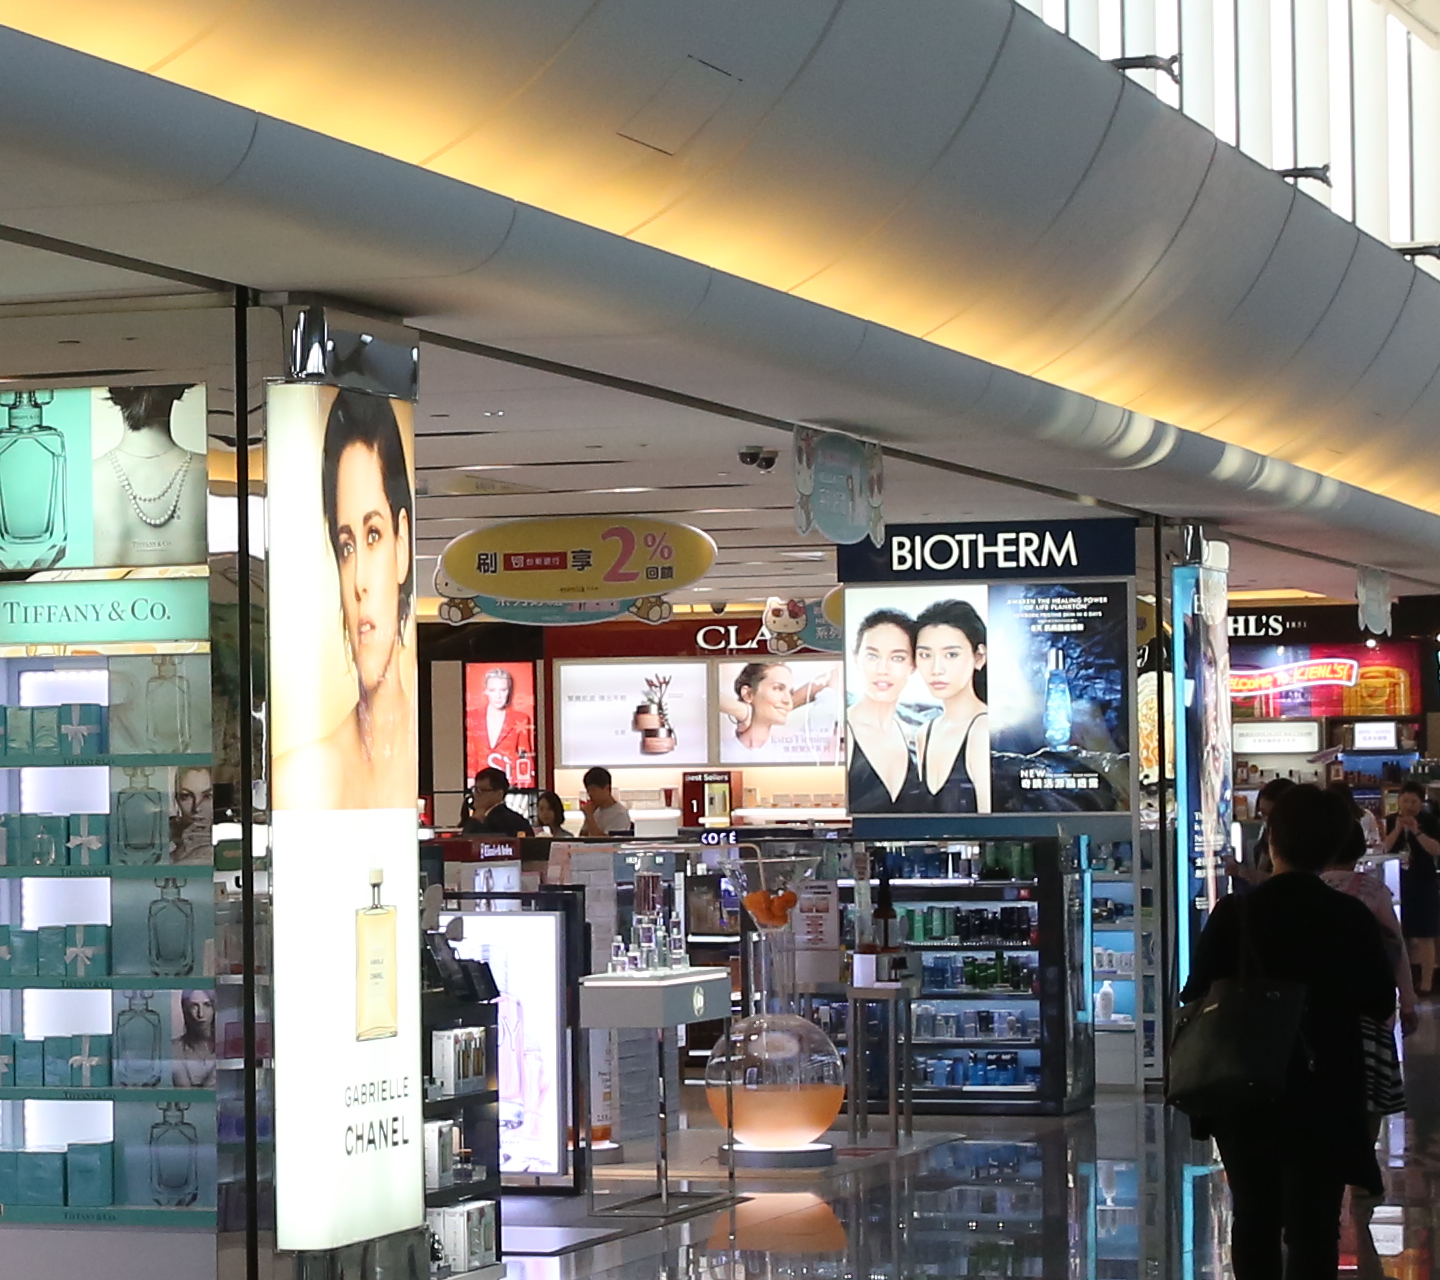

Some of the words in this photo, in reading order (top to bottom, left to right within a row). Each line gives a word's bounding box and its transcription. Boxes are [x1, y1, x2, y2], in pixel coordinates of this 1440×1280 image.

[476, 552, 498, 574] 刷
[571, 549, 593, 572] 享
[601, 526, 674, 584] 2%
[891, 530, 1079, 571] BIOTHERM
[645, 566, 674, 580] 回饋
[3, 600, 103, 624] TIFFANY
[108, 600, 127, 621] &
[130, 598, 171, 621] CO.
[1229, 676, 1272, 692] ELCOME
[1273, 671, 1290, 685] TO
[1294, 663, 1350, 683] KIEHL'S!
[703, 773, 729, 781] Sellers
[1021, 769, 1046, 778] NEW
[691, 799, 698, 813] 1
[345, 1076, 410, 1109] GABRIELLE
[345, 1115, 410, 1157] CHANEL
